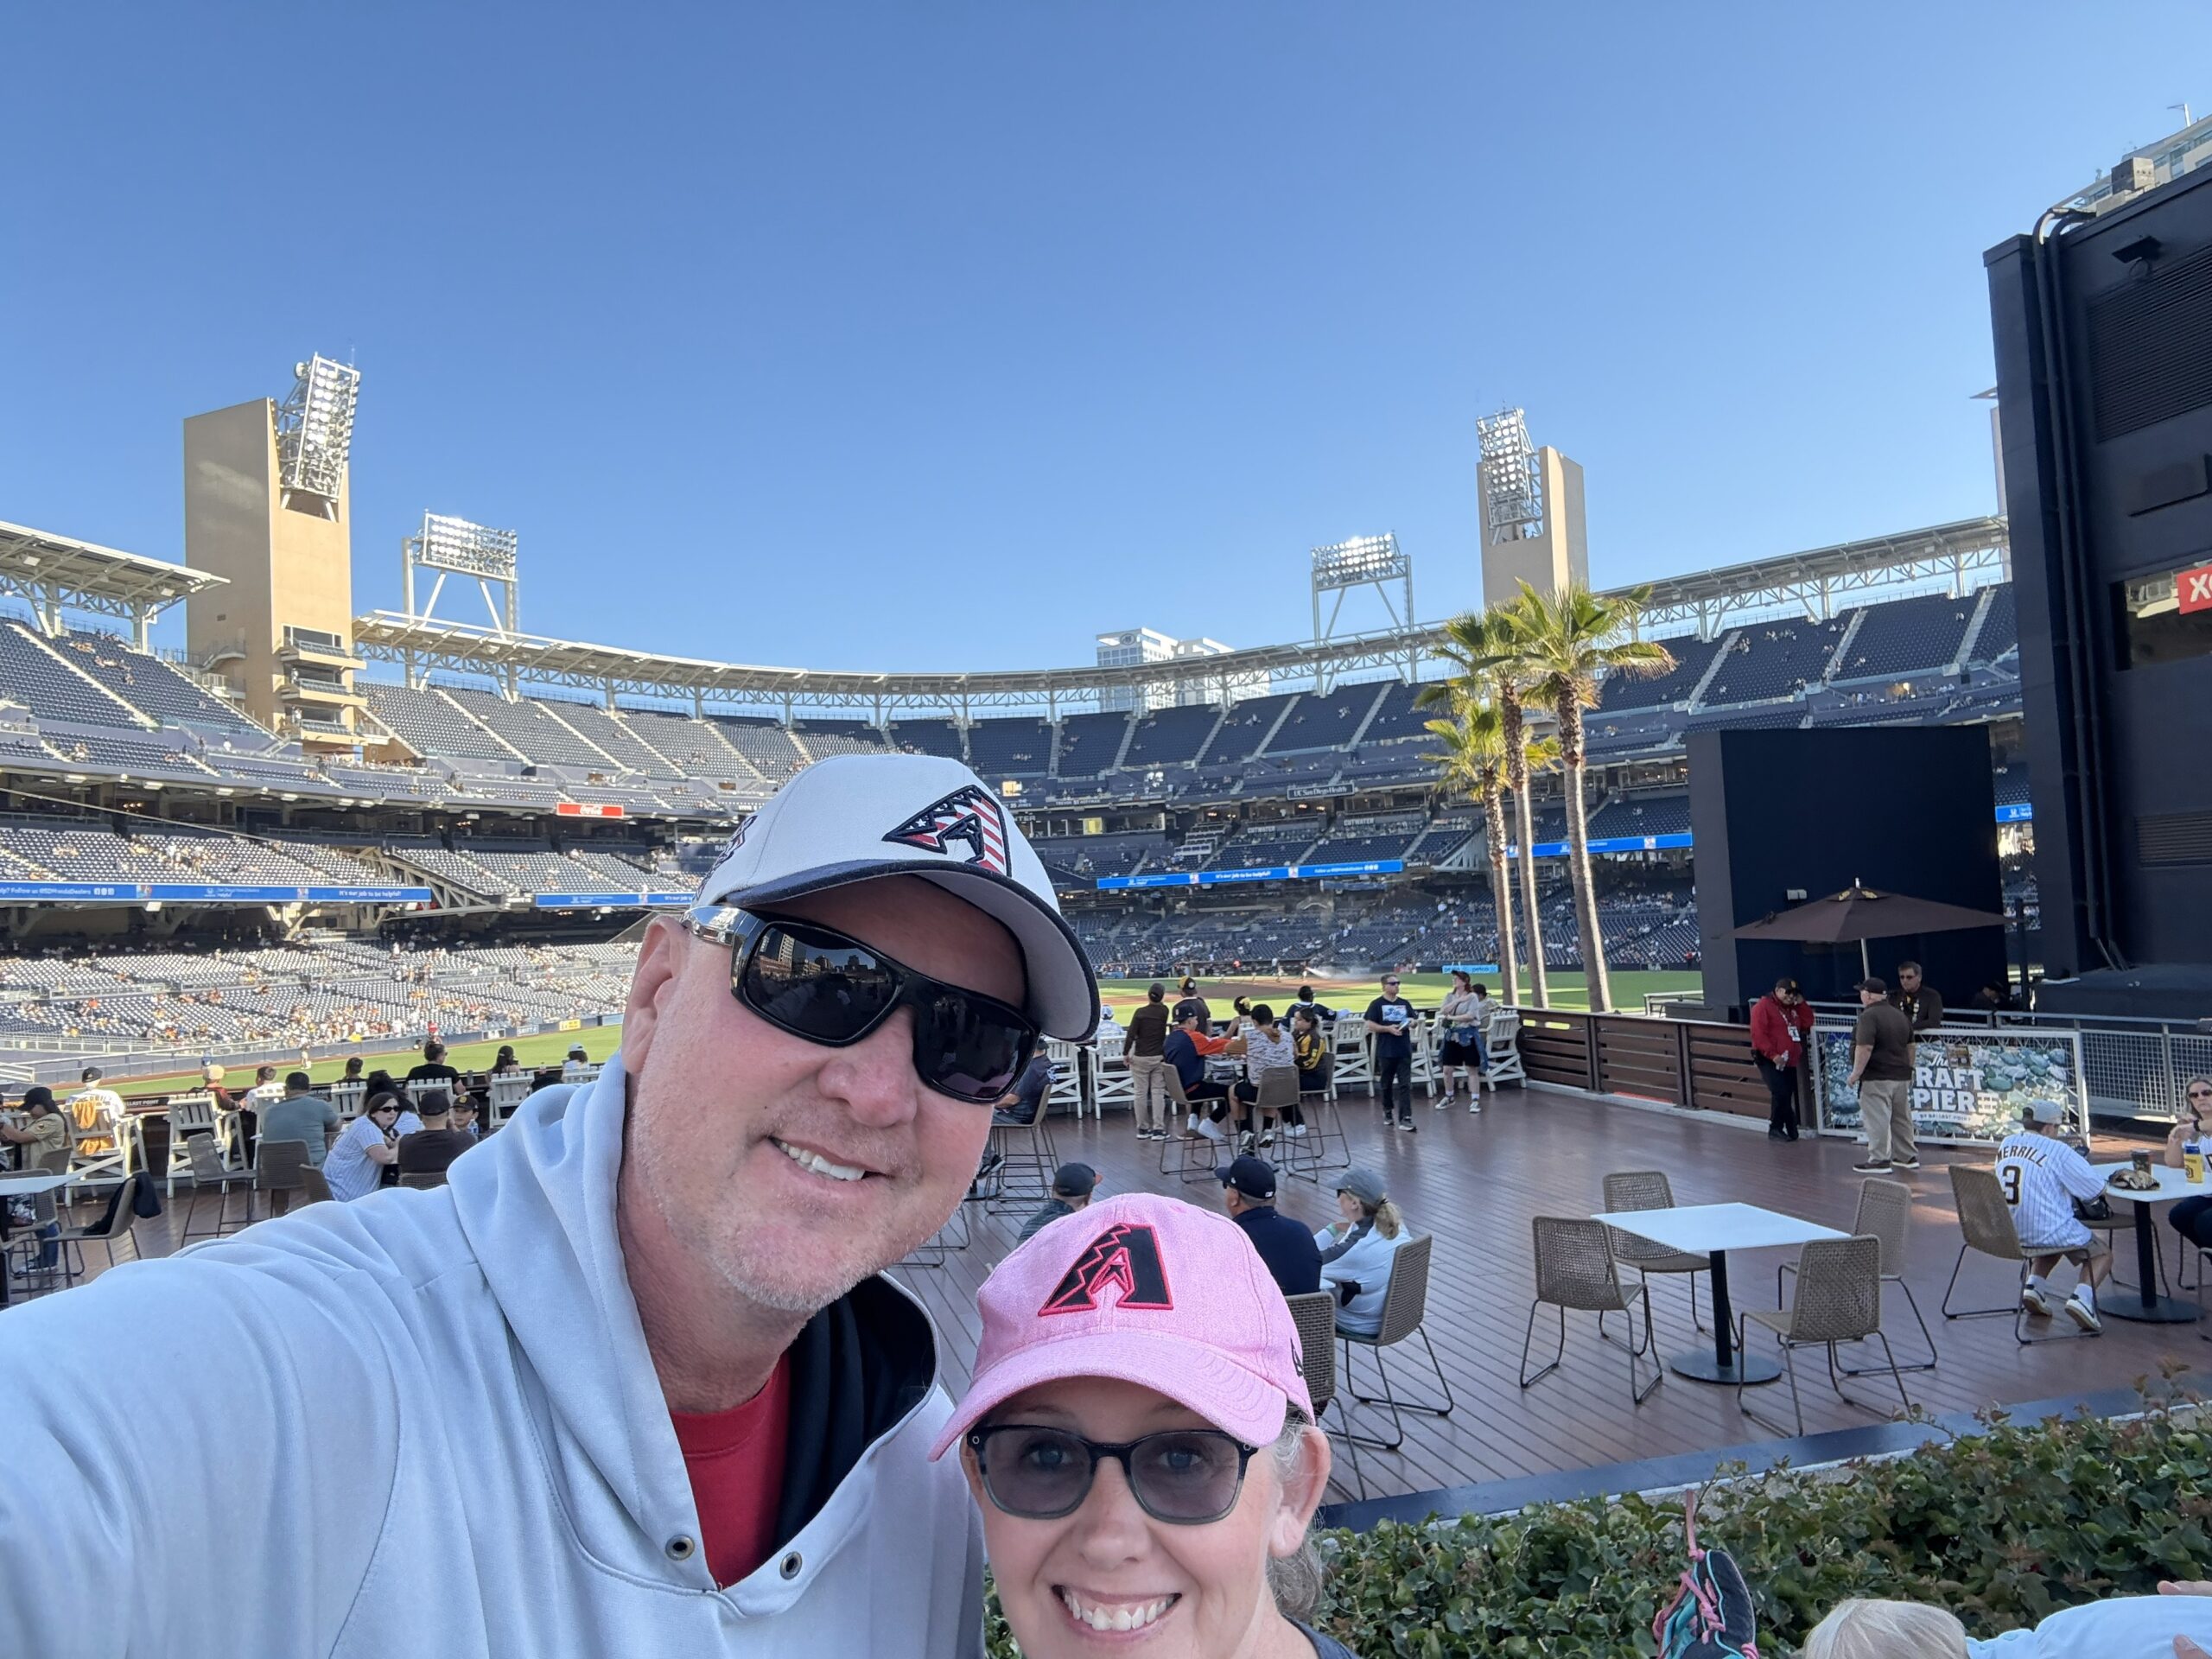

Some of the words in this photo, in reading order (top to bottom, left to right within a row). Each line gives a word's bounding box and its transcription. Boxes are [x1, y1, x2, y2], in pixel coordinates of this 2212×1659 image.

[2189, 573, 2212, 602] X
[1914, 1066, 1985, 1090] RAFT
[1912, 1088, 1977, 1113] PIER
[2002, 1165, 2021, 1205] 3
